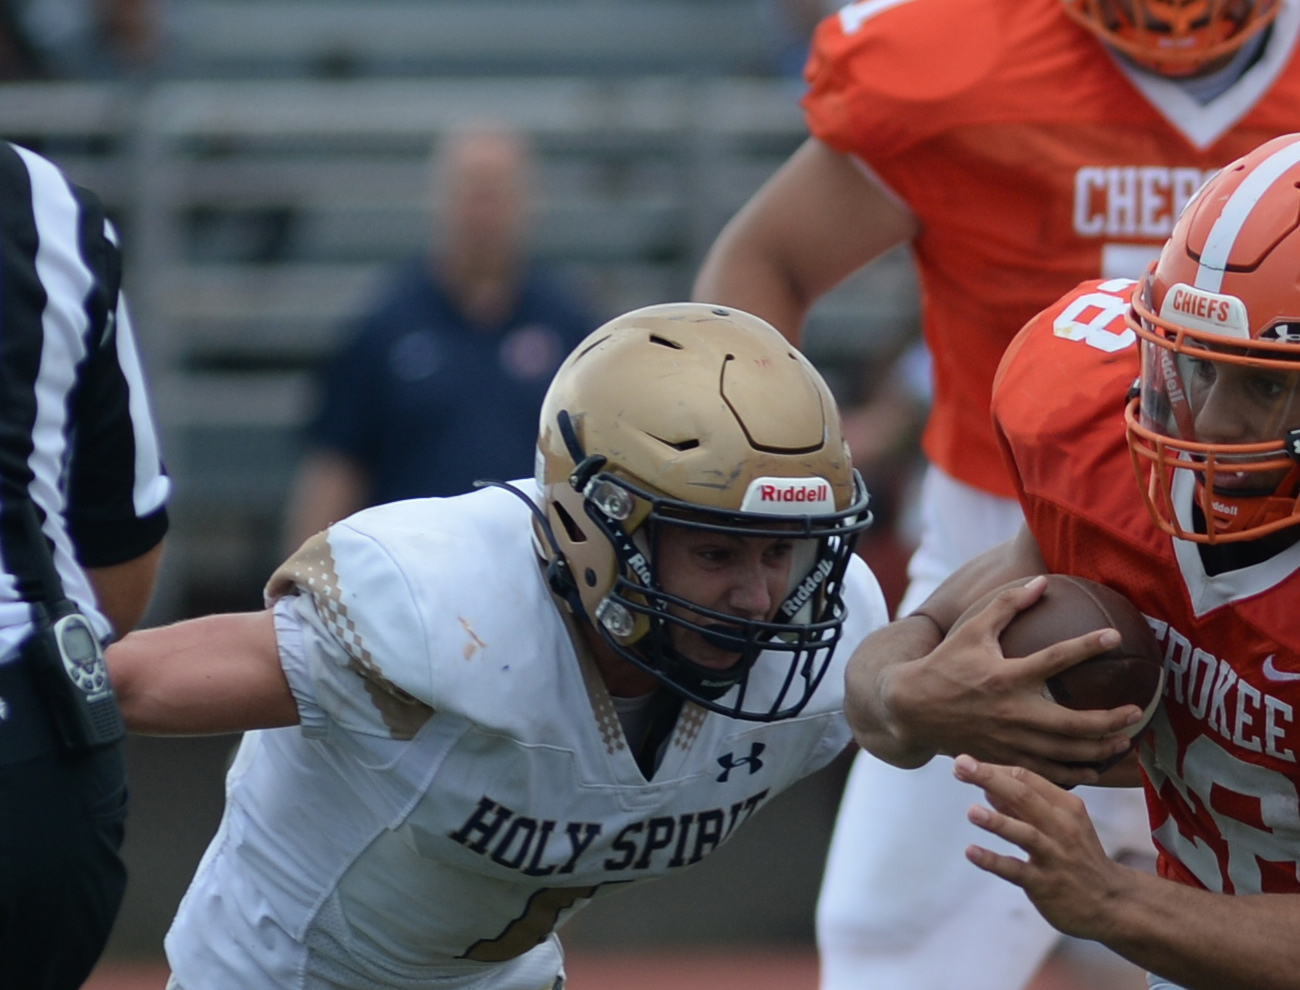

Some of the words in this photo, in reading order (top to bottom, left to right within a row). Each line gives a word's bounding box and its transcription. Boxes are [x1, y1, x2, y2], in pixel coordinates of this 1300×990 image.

[1073, 166, 1222, 238] CHER
[1053, 278, 1139, 352] 8
[1173, 289, 1230, 323] CHIEFS
[760, 484, 828, 503] Riddell
[780, 559, 834, 617] Riddell
[448, 794, 604, 876] HOLY
